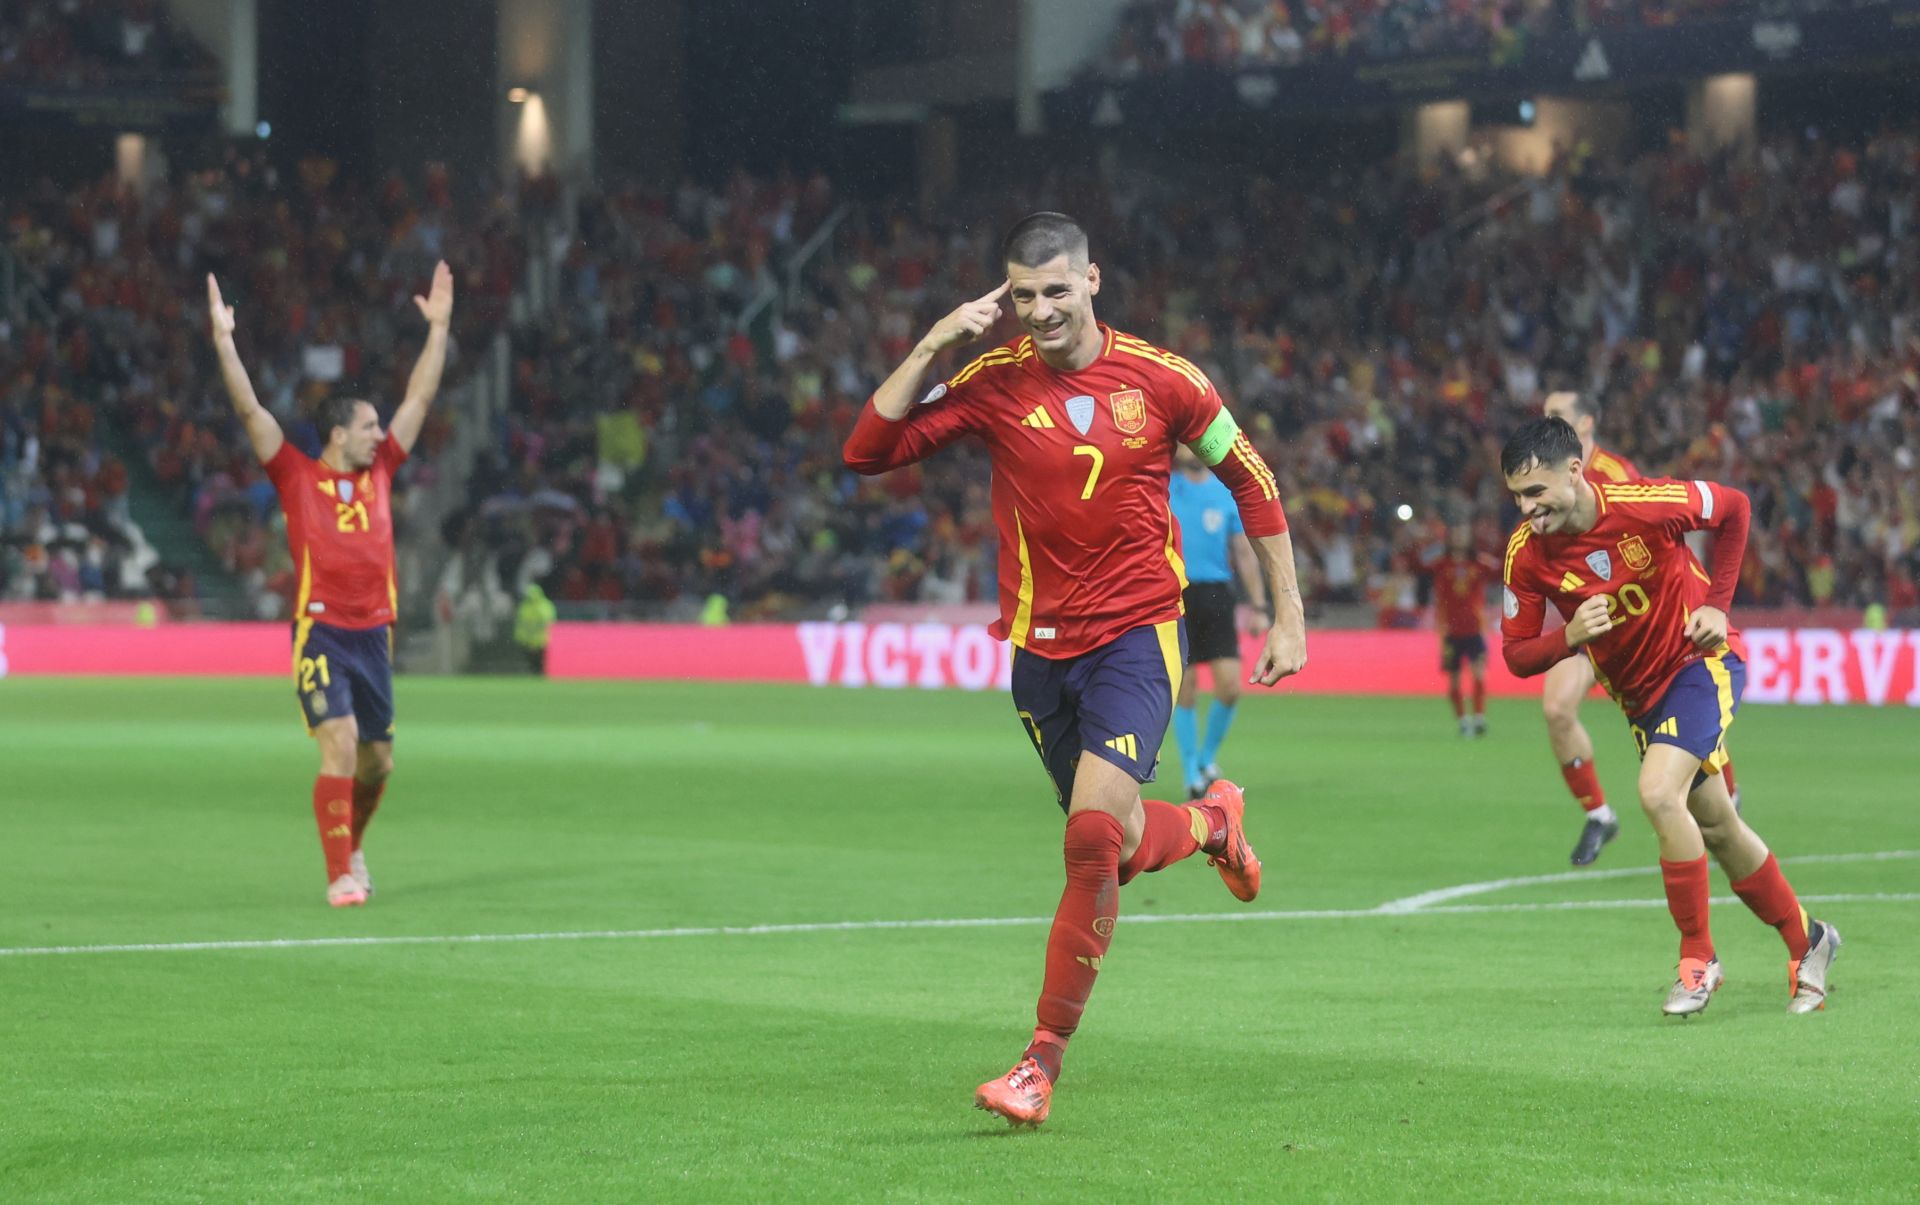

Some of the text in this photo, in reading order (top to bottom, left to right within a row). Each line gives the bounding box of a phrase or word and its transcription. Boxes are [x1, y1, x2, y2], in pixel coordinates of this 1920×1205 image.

[1073, 445, 1104, 500] 7
[336, 501, 369, 532] 21
[301, 654, 330, 692] 21
